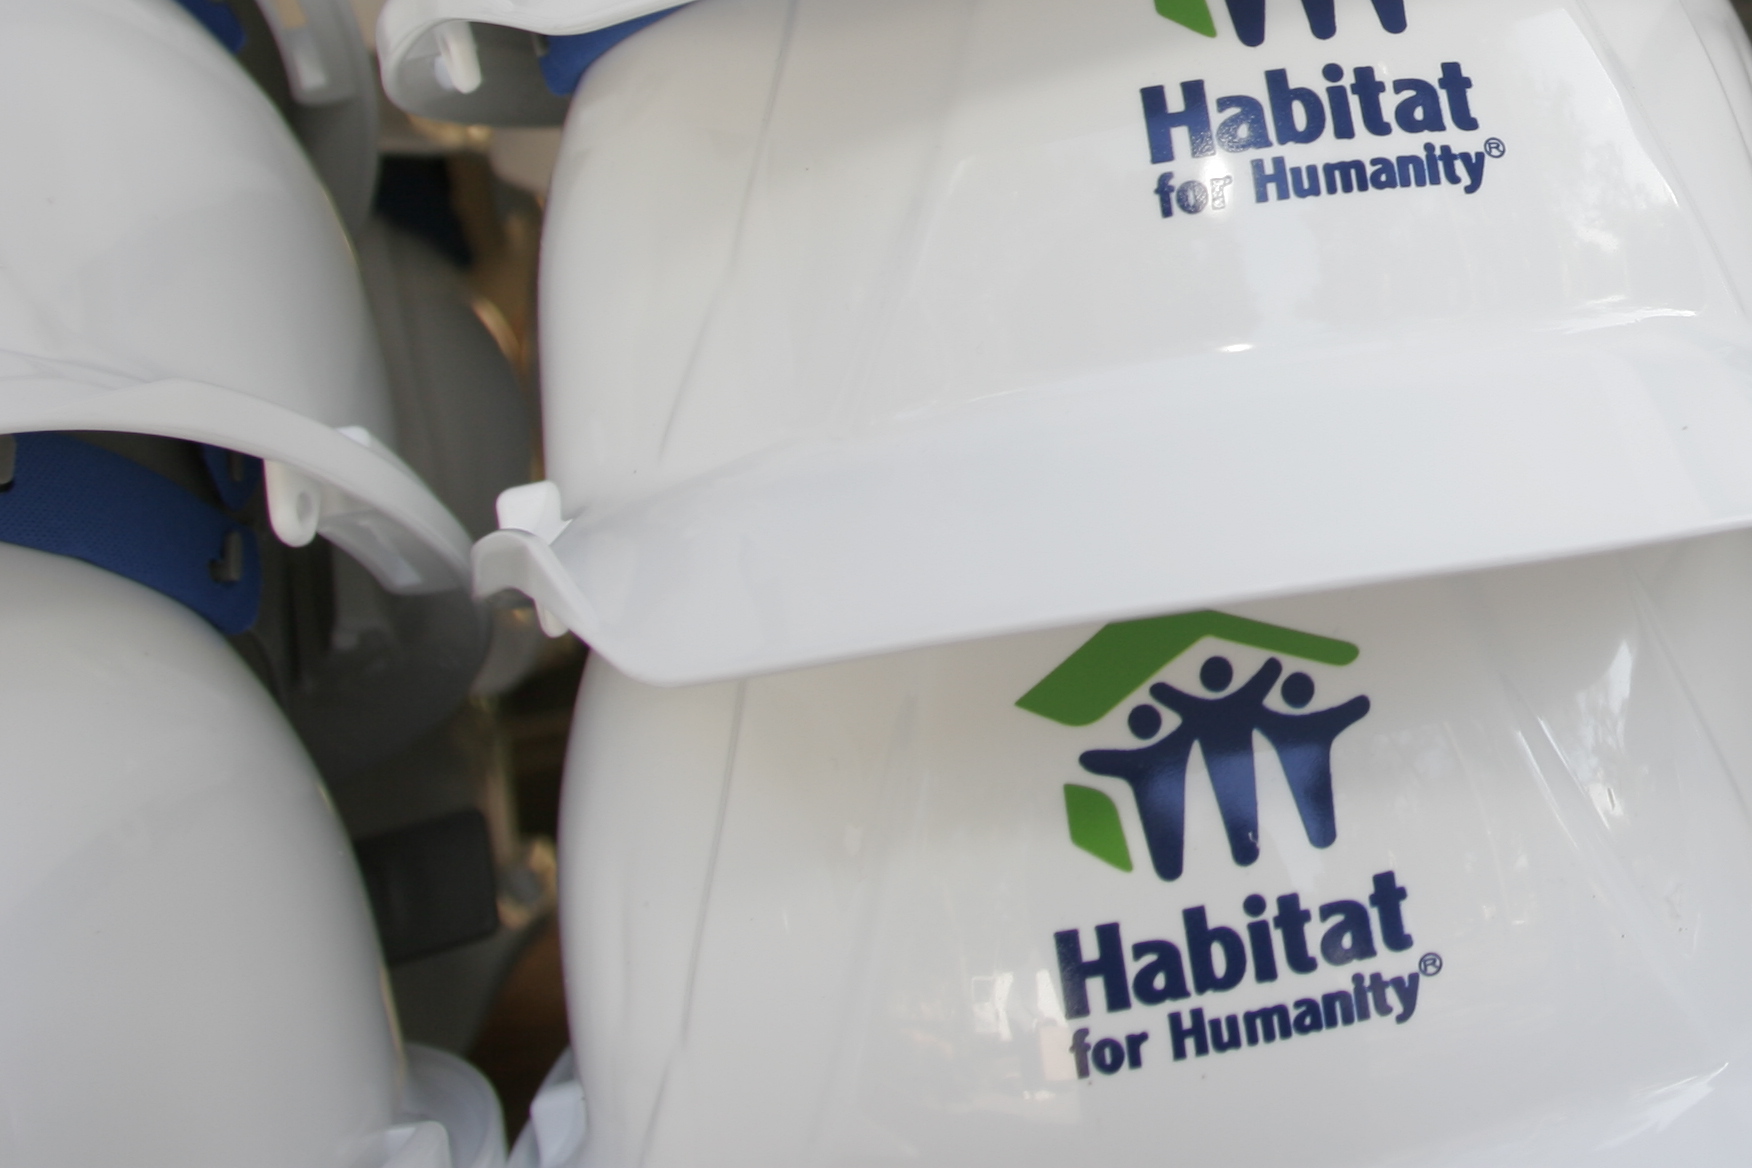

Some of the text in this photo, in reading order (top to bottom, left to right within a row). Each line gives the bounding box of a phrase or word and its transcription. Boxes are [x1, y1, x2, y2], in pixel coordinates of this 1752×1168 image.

[1139, 61, 1479, 164] Habitat
[1153, 170, 1233, 219] for
[1053, 870, 1414, 1021] Habitat
[1069, 1027, 1150, 1080] for
